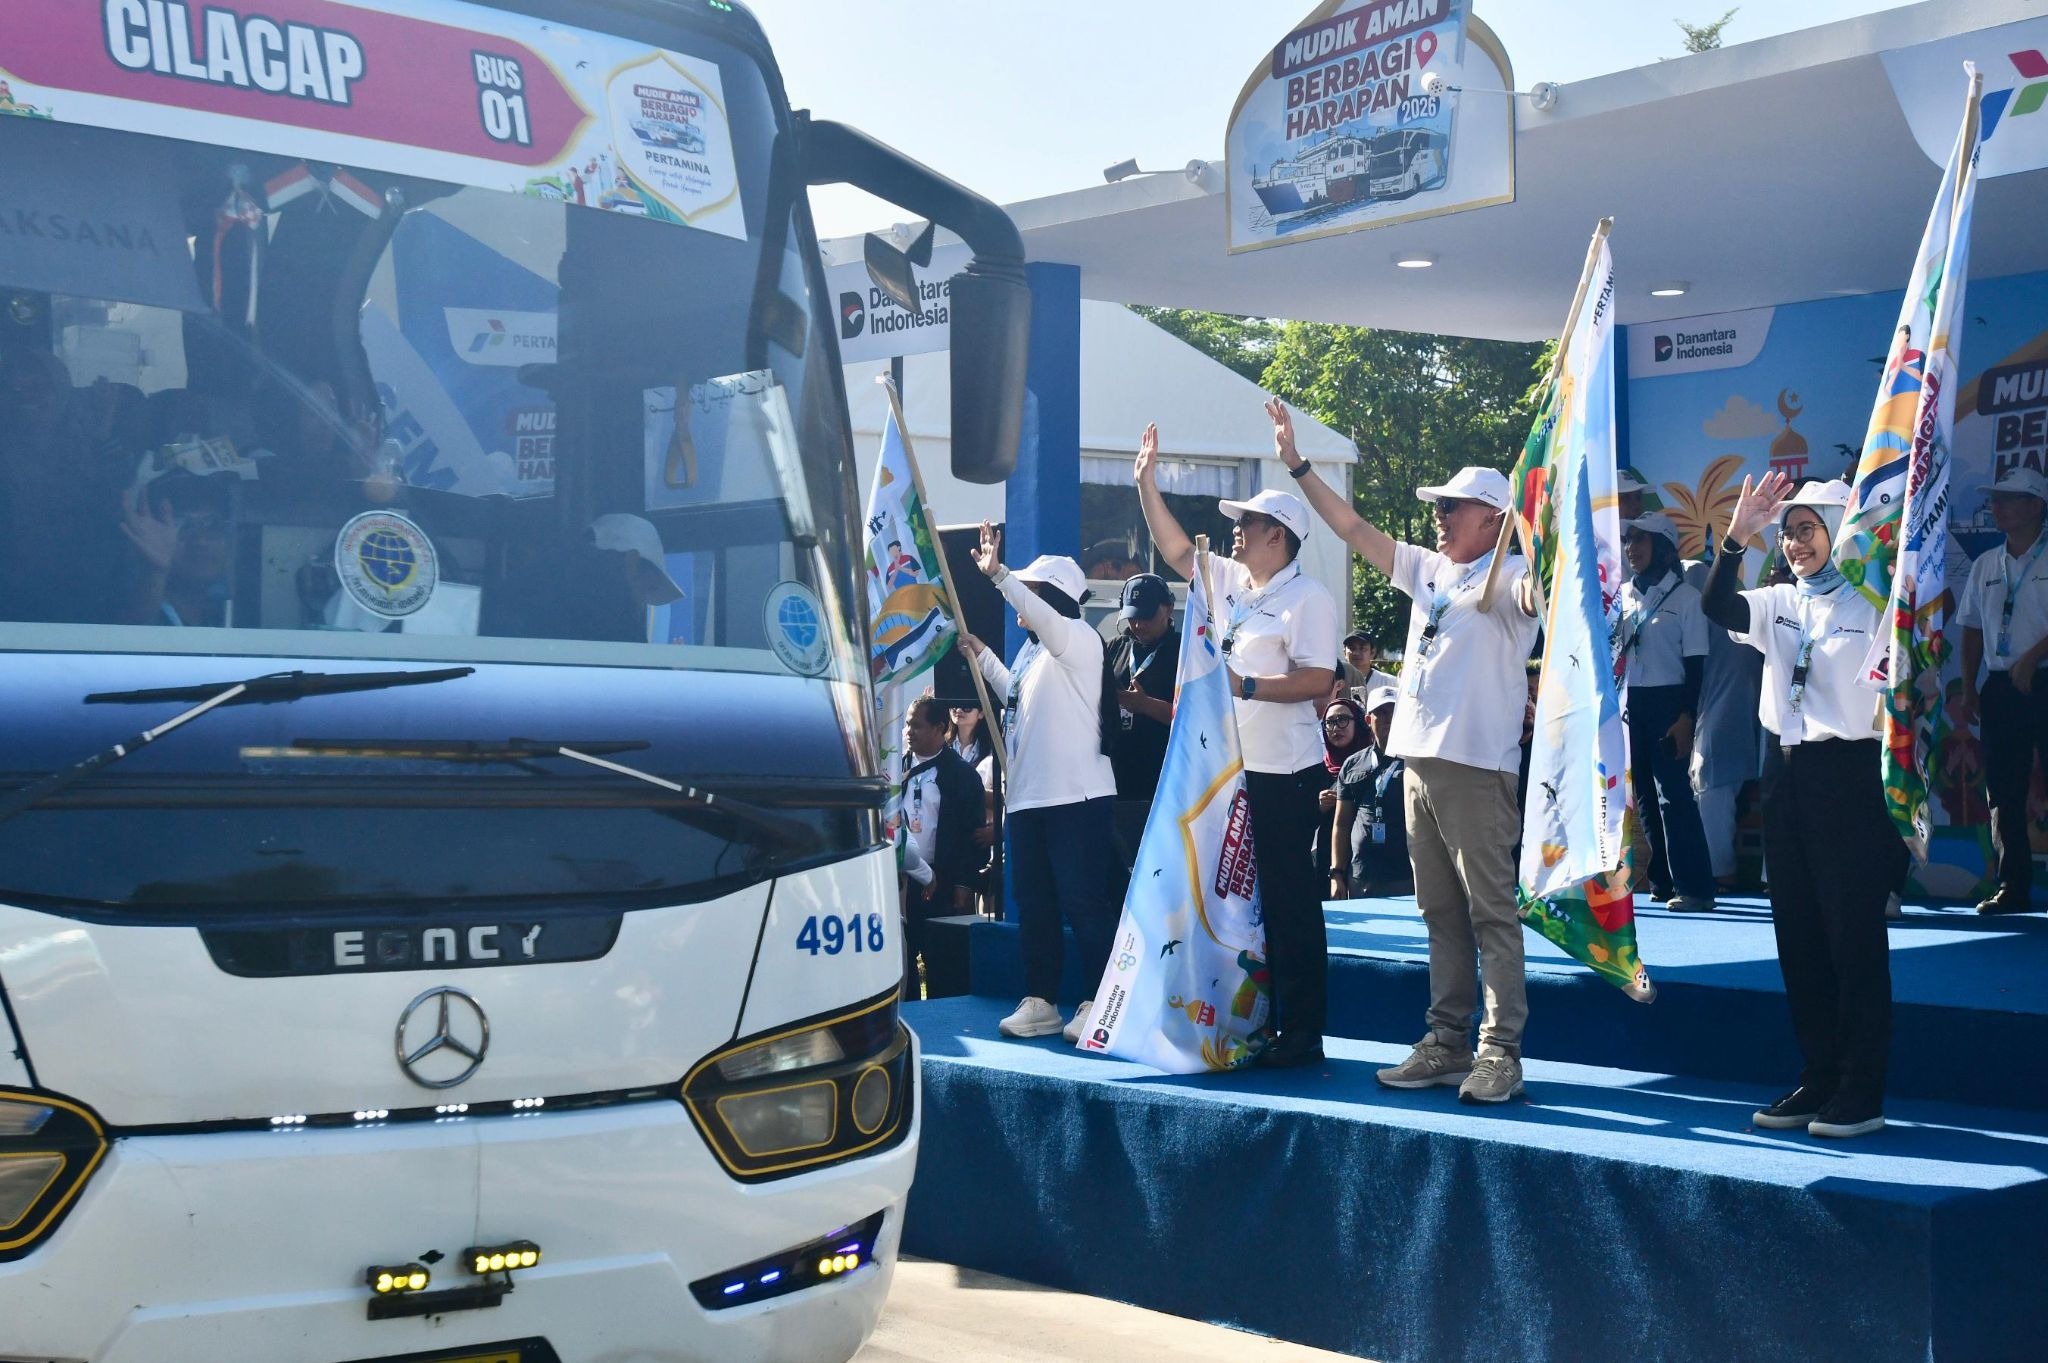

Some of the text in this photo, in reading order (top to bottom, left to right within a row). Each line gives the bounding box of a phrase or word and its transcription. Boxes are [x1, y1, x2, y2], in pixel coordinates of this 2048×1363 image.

[105, 0, 362, 103] CILACAP
[1284, 0, 1438, 69] MUDIK AMAN
[474, 53, 522, 90] BUS
[1286, 37, 1413, 110] BERBAGI
[638, 87, 697, 105] MUDIK AMAN
[641, 99, 689, 116] BERBAGI
[1286, 74, 1410, 141] HARAPAN
[1401, 98, 1437, 122] 2026
[482, 89, 530, 144] 01
[642, 109, 689, 124] HARAPAN
[645, 151, 711, 175] PERTAMINA
[869, 279, 950, 309] Datara
[870, 302, 949, 335] Indonesia
[513, 334, 556, 349] PERTA
[1676, 329, 1737, 346] Danantara
[1676, 341, 1733, 360] Indonesia
[1217, 796, 1248, 892] MUDIK AMAN
[795, 912, 884, 955] 4918
[1098, 984, 1120, 1026] Danantara
[1106, 989, 1126, 1030] Indonesia
